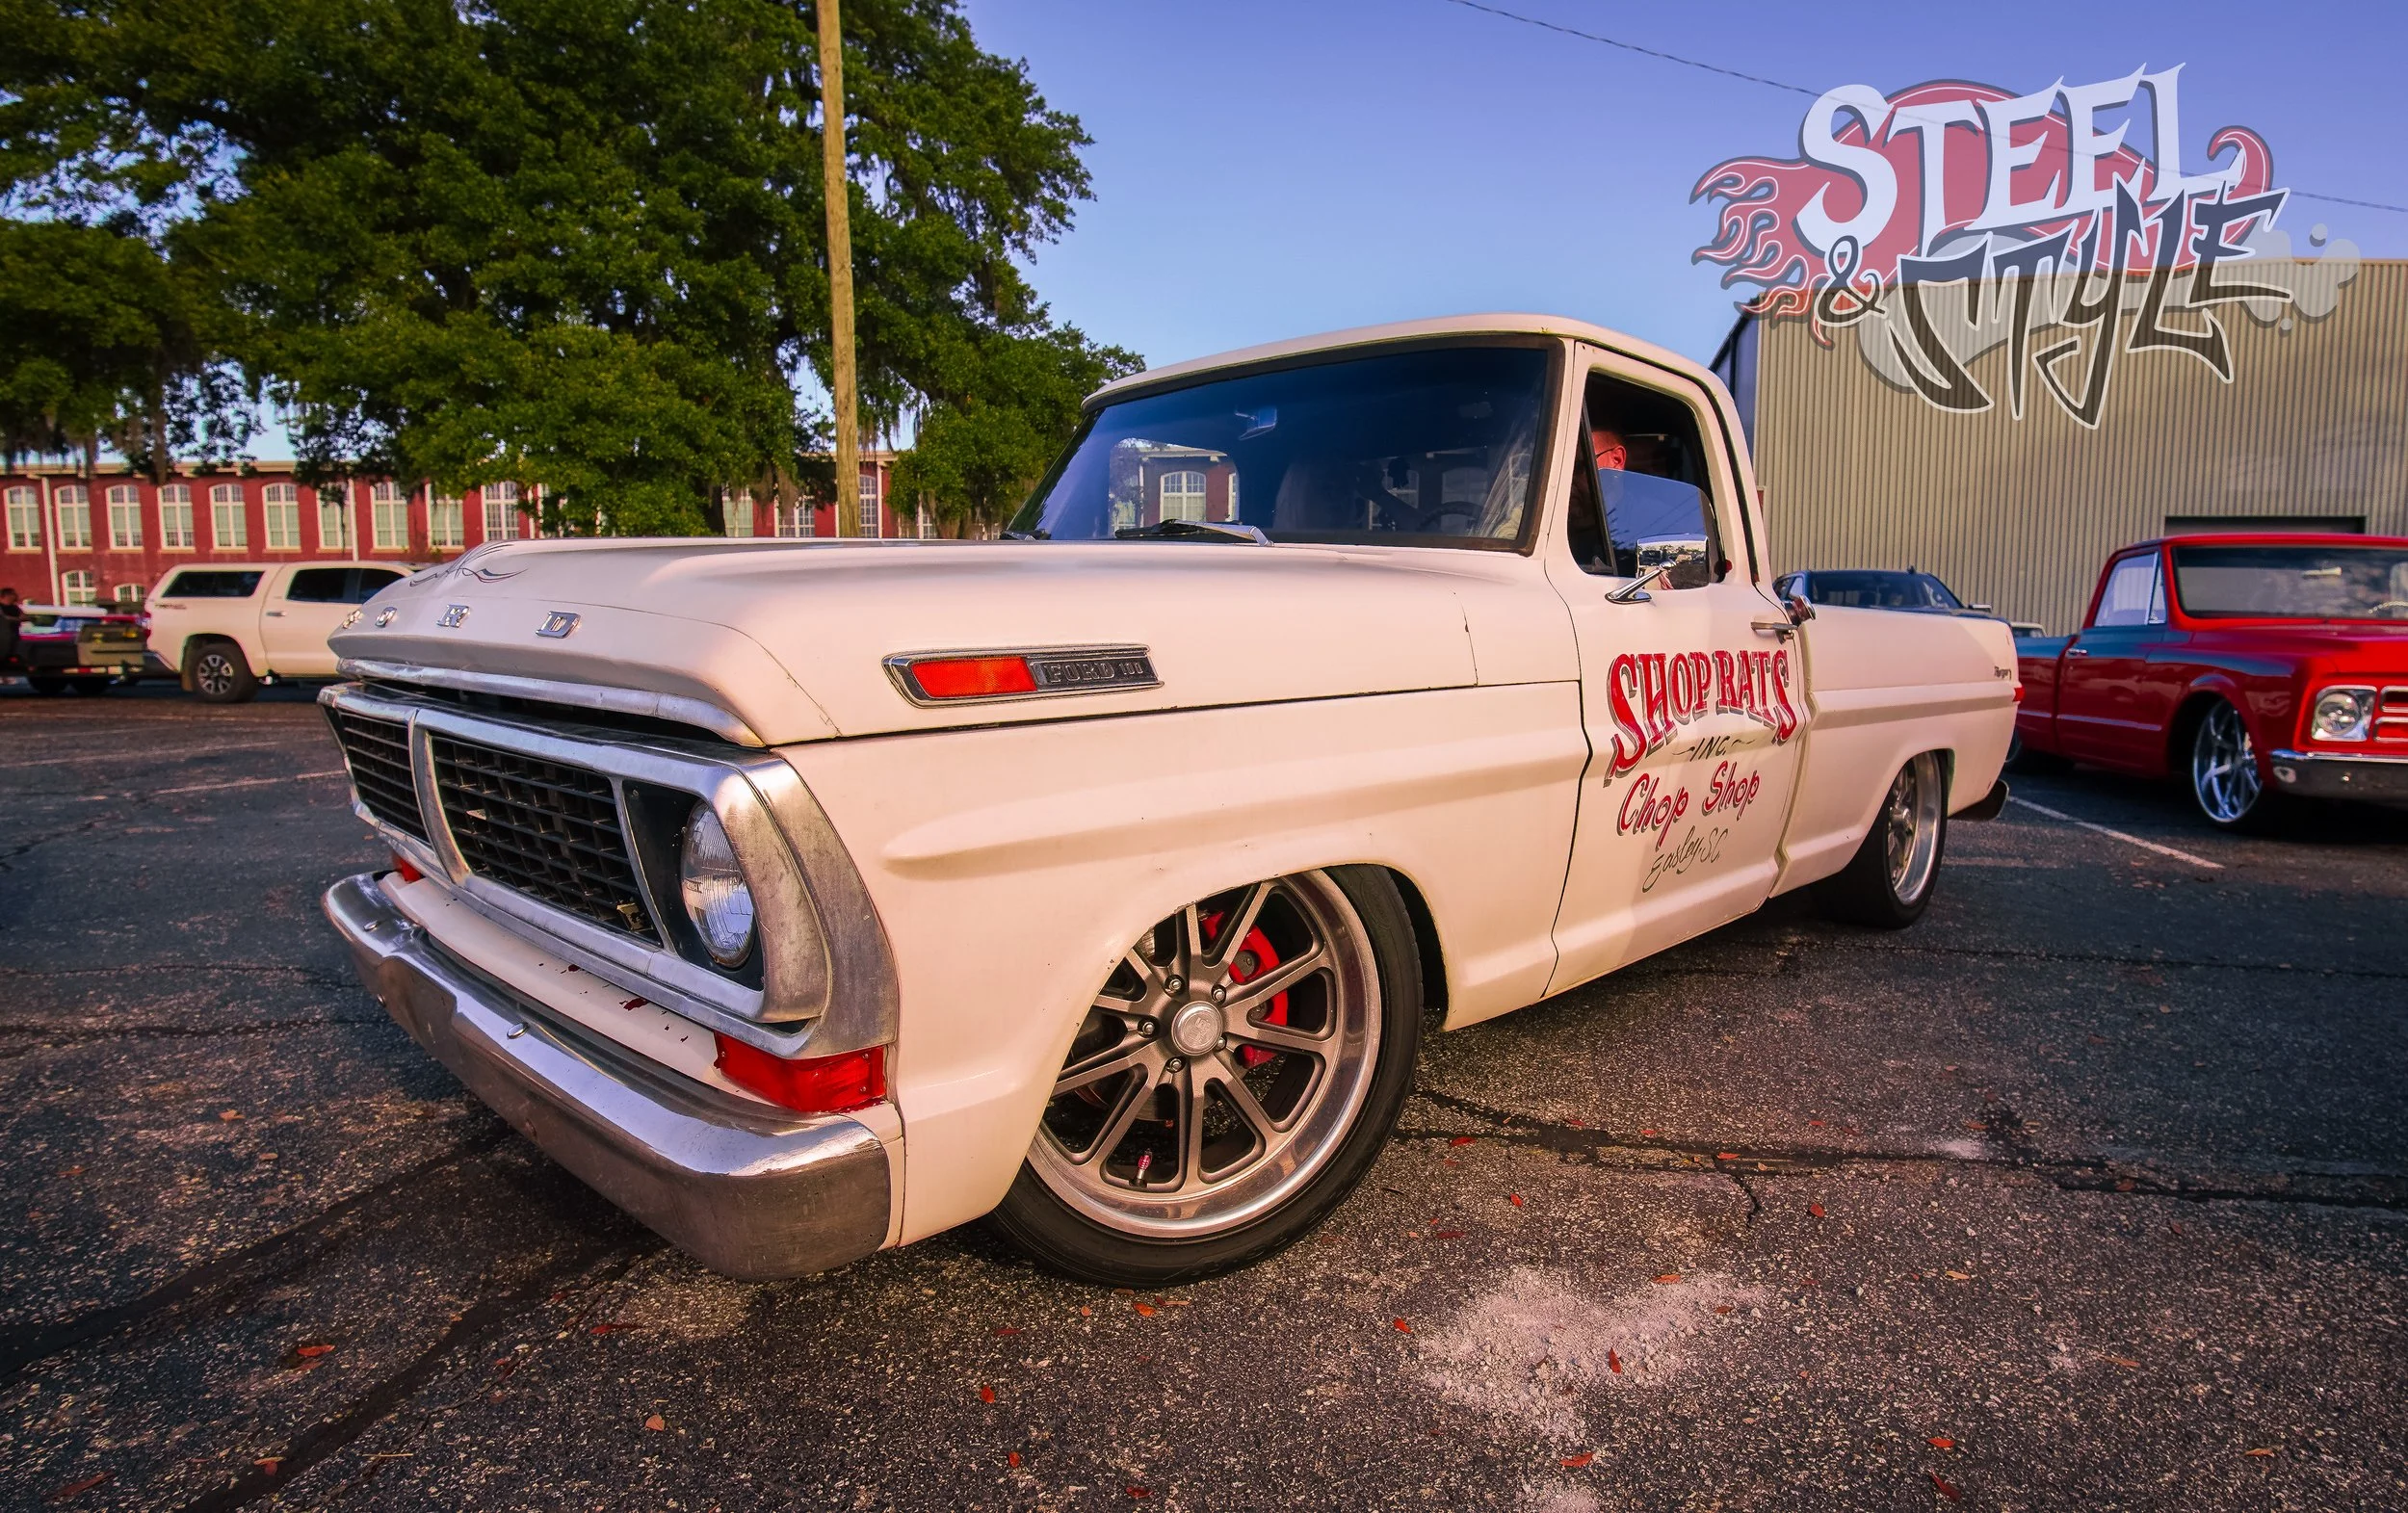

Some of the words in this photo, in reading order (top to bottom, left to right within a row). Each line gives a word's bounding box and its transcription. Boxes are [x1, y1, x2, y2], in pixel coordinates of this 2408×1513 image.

[1043, 662, 1114, 683] FORD
[1118, 662, 1144, 675] 100
[1616, 772, 1690, 852] Chop
[1701, 760, 1761, 822] Shop
